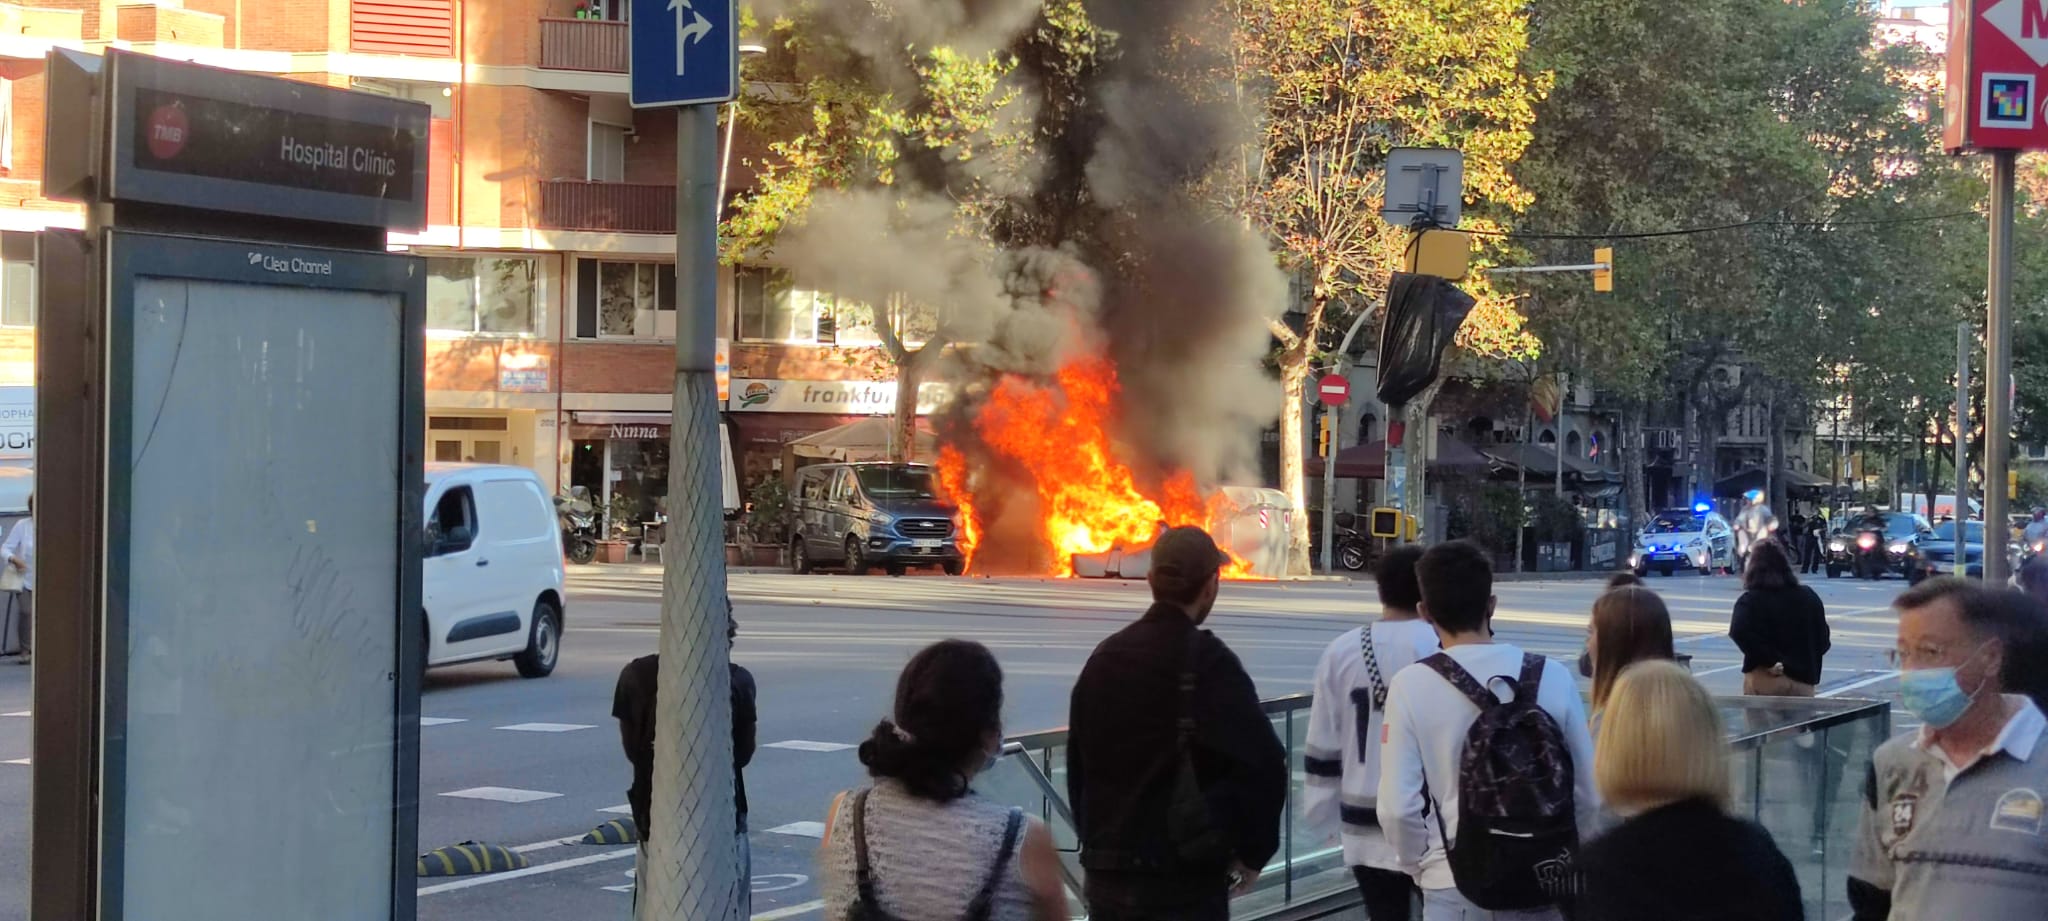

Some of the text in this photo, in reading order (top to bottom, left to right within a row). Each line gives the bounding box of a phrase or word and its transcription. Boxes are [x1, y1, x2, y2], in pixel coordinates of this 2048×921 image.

[153, 124, 182, 142] TMB
[281, 136, 396, 177] Hospital Clínic
[263, 256, 332, 274] Clear Channel
[610, 424, 659, 439] Ninna
